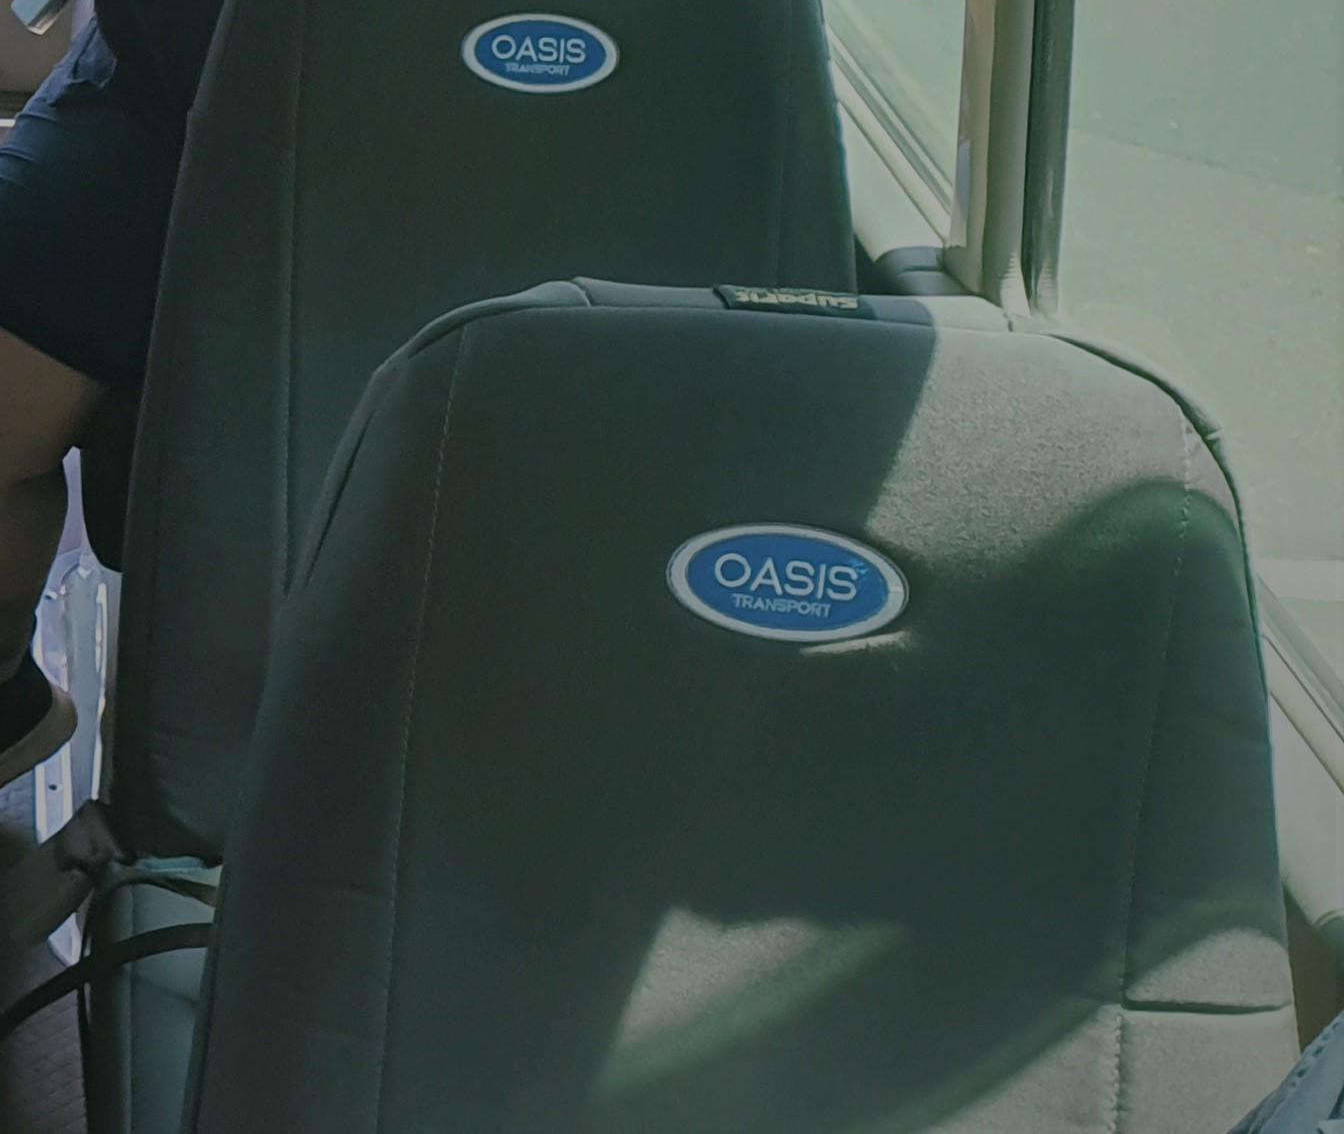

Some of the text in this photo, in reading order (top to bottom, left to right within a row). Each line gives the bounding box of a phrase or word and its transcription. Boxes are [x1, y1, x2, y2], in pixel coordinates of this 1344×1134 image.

[491, 34, 586, 64] OASIS
[504, 62, 570, 76] TRANSPORT
[714, 552, 858, 601] OASIS
[732, 593, 831, 618] TRANSPORT
